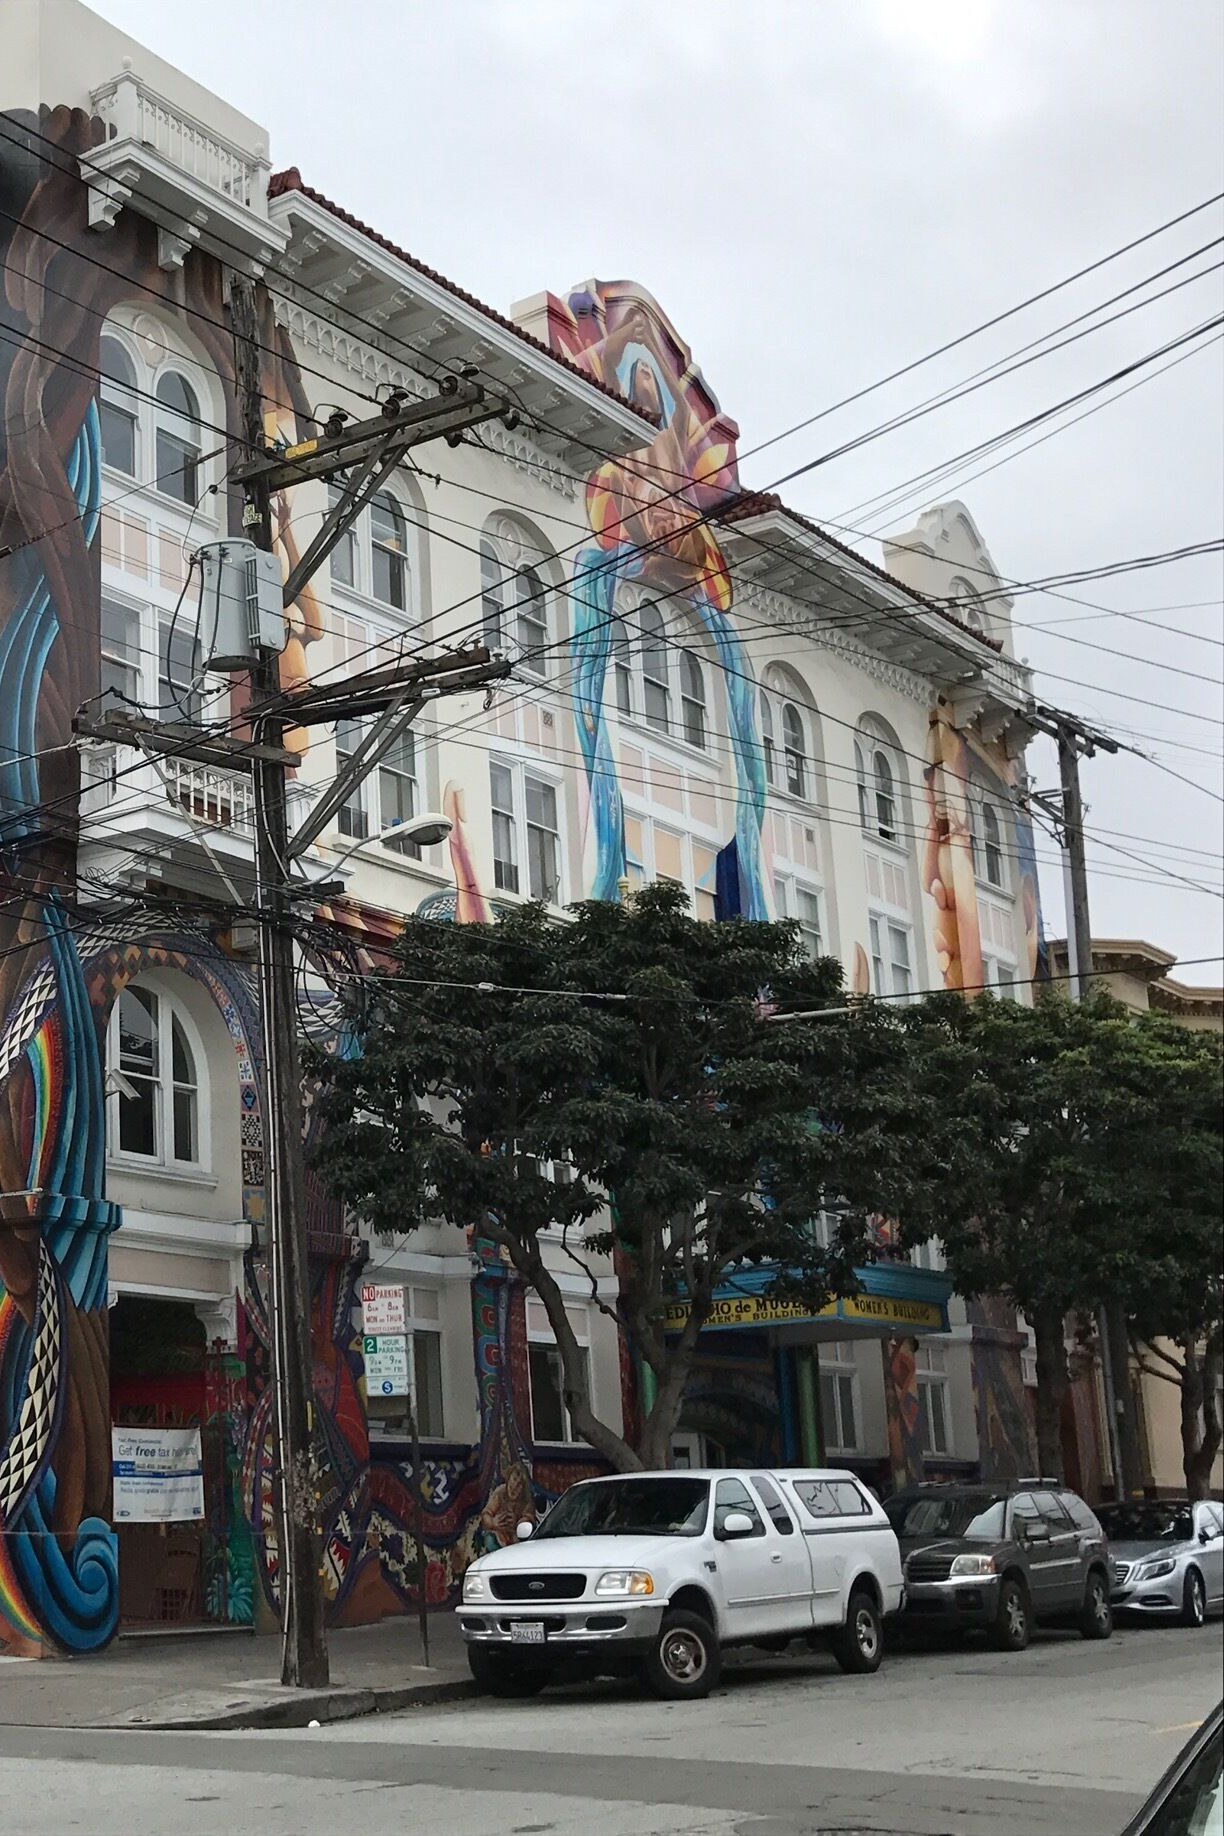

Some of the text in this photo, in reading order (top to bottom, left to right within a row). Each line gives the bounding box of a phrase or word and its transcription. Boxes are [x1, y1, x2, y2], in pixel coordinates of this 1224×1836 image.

[363, 1287, 402, 1300] NO PARKING
[665, 1302, 732, 1320] EDIIO
[735, 1301, 751, 1313] de
[703, 1314, 742, 1325] OMEN'S
[366, 1338, 375, 1352] 2
[118, 1445, 132, 1456] Get
[135, 1446, 156, 1457] free
[158, 1448, 170, 1457] tax
